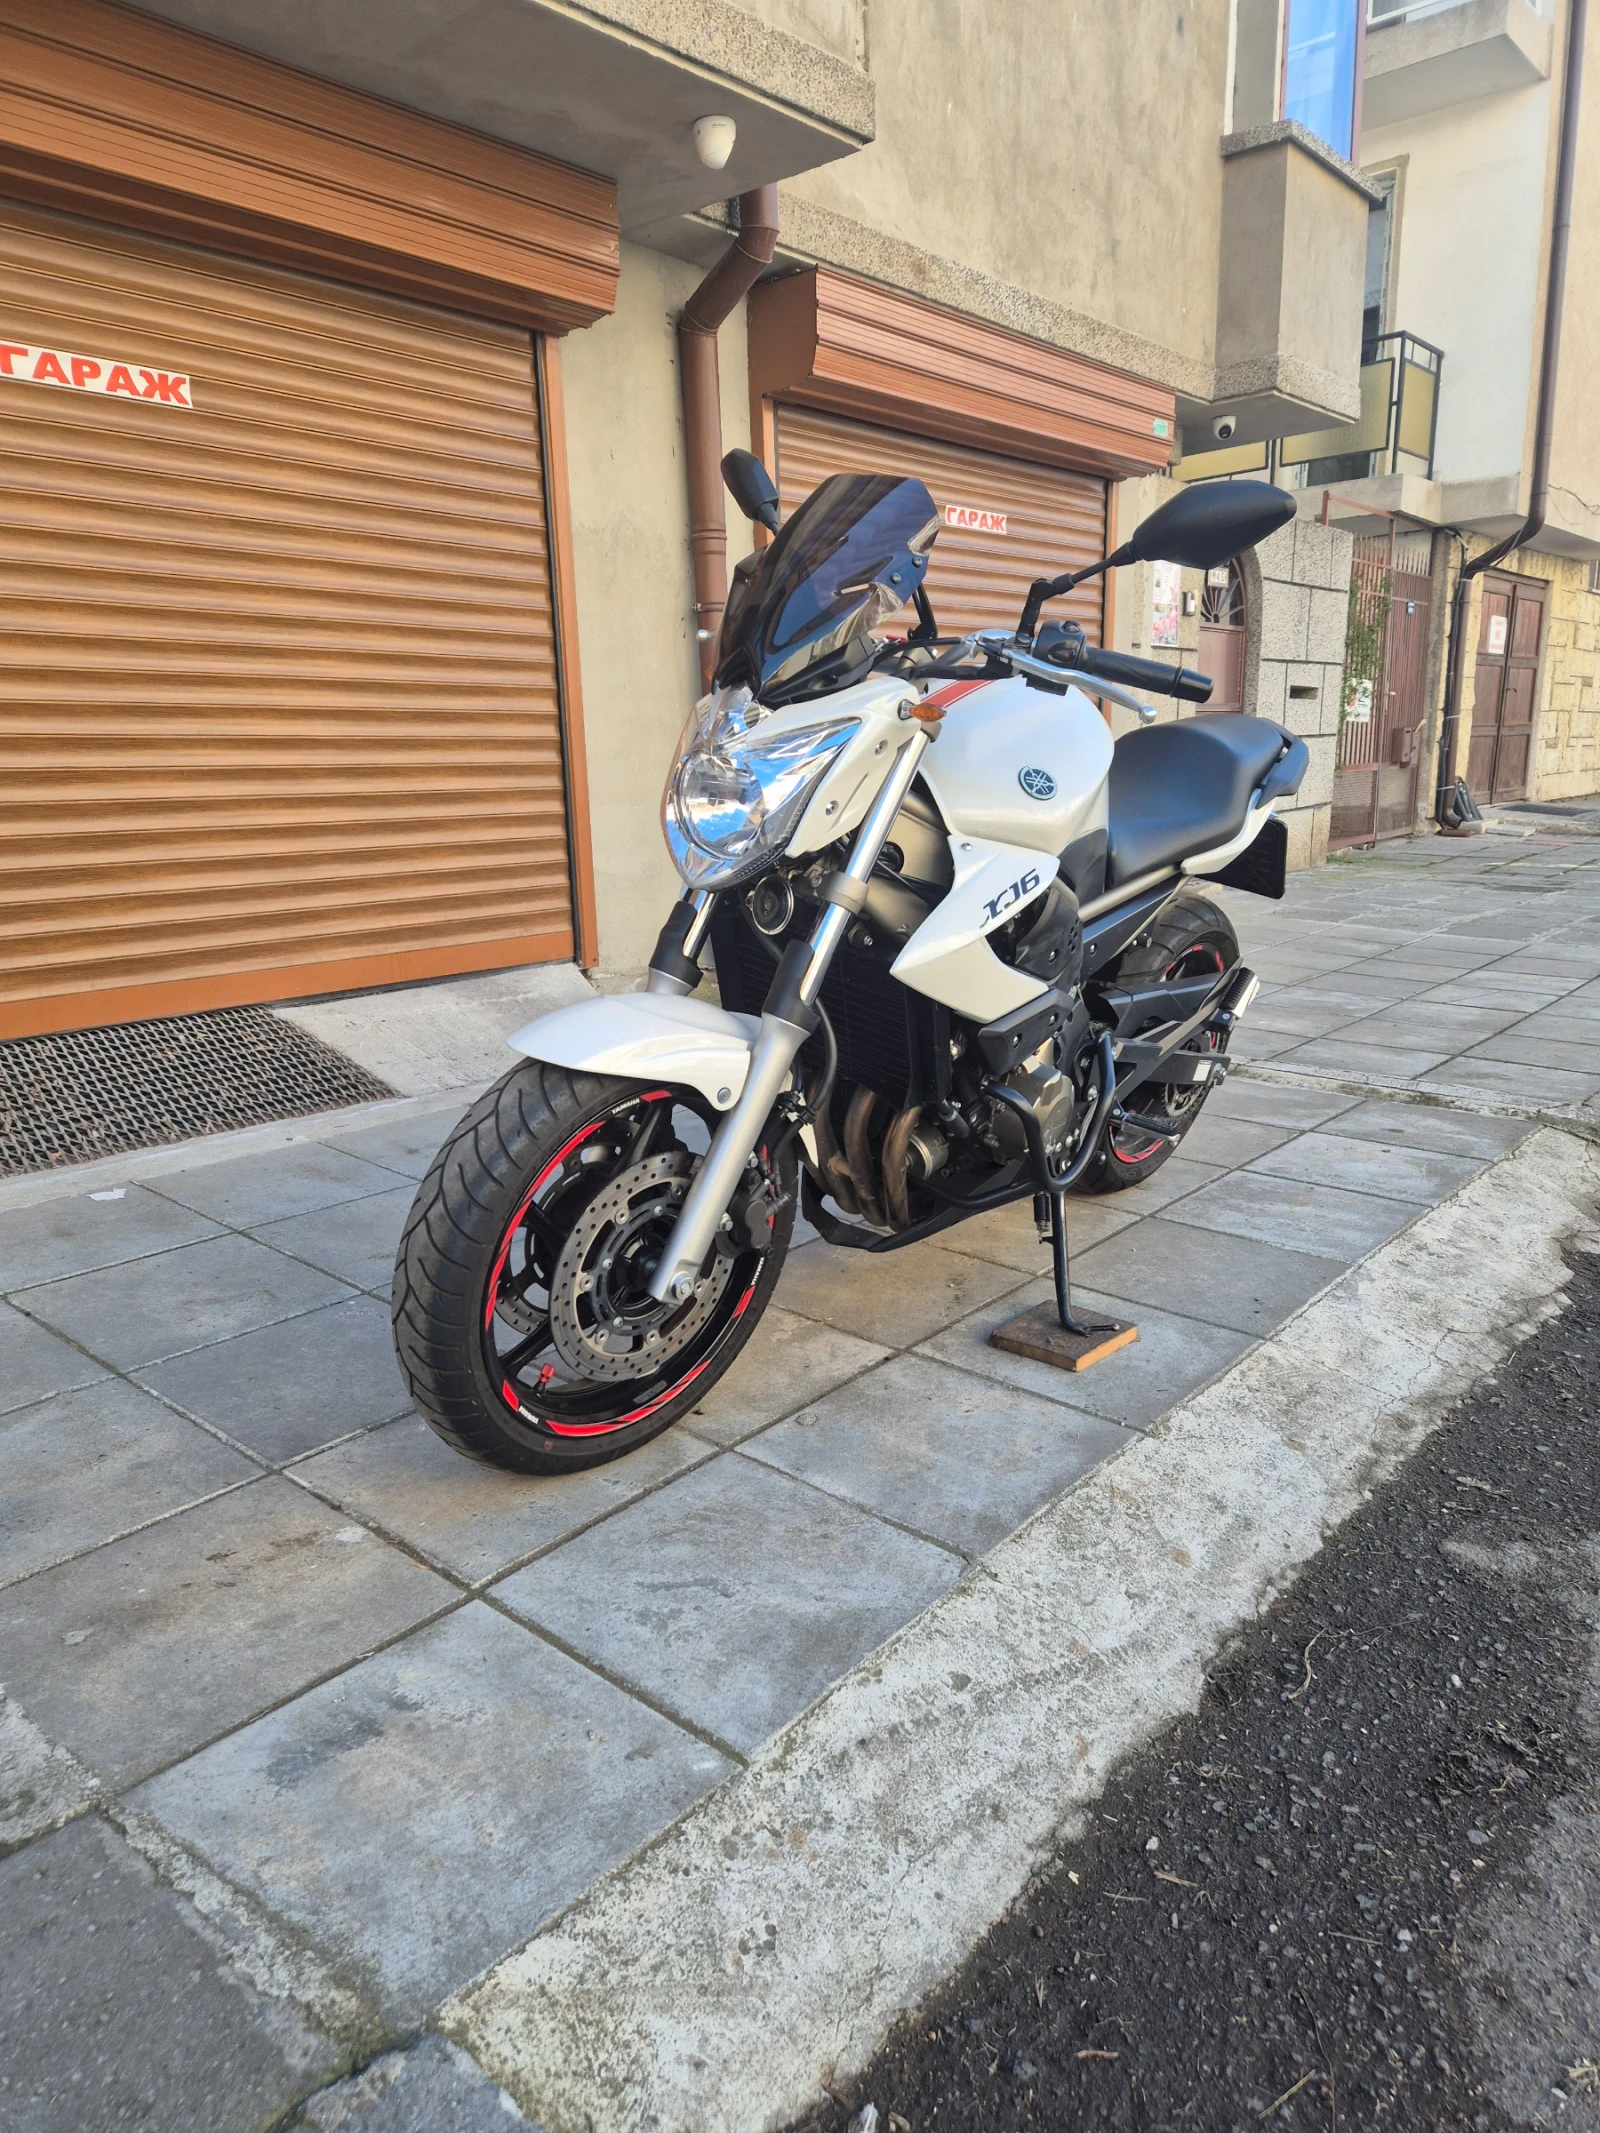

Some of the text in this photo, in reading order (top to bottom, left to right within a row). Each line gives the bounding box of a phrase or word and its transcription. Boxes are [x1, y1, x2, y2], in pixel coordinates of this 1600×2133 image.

[0, 344, 189, 405] ГАРАЖ
[946, 506, 1005, 532] ГАРАЖ
[979, 868, 1040, 929] XJ6
[611, 1098, 640, 1115] YAMAHA
[750, 1256, 765, 1286] YAMAHA
[518, 1405, 539, 1425] YAMAHA
